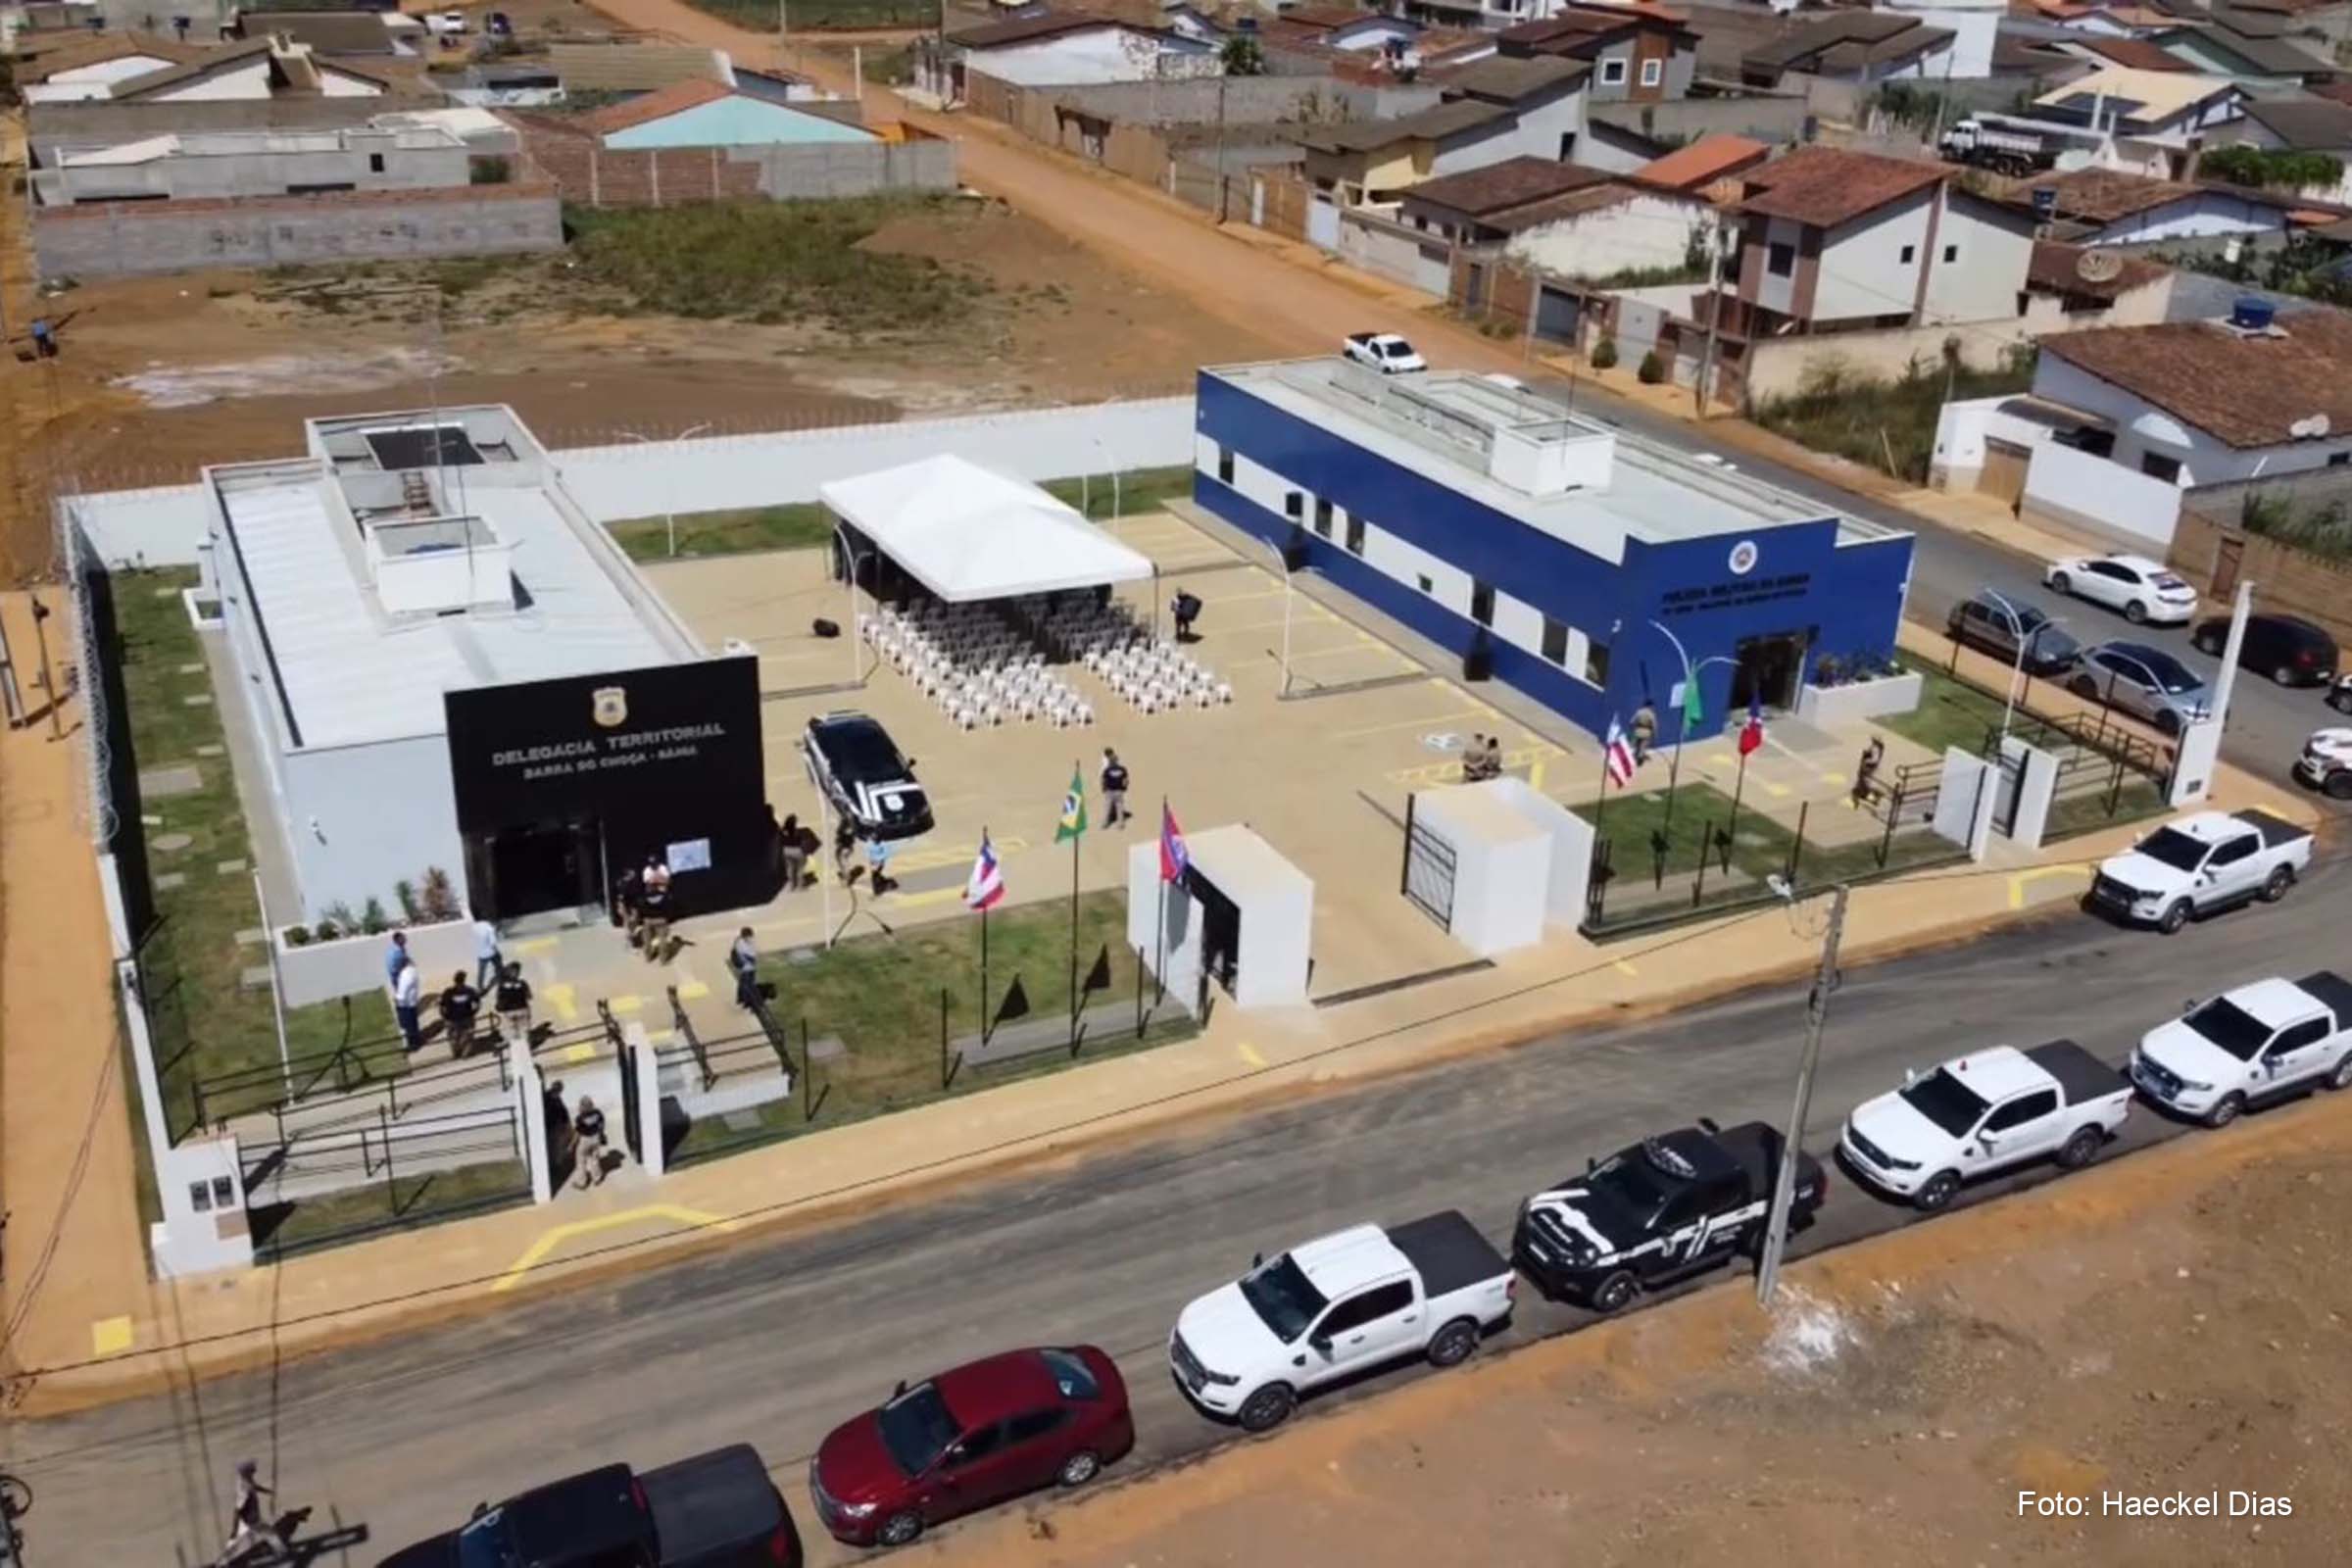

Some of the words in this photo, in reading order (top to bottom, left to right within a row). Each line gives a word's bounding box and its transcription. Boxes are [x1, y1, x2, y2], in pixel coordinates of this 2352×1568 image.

[492, 740, 597, 766] DELEGACIA
[607, 722, 725, 751] TERRITORIAL
[522, 763, 574, 780] BARRA
[577, 760, 597, 772] DO
